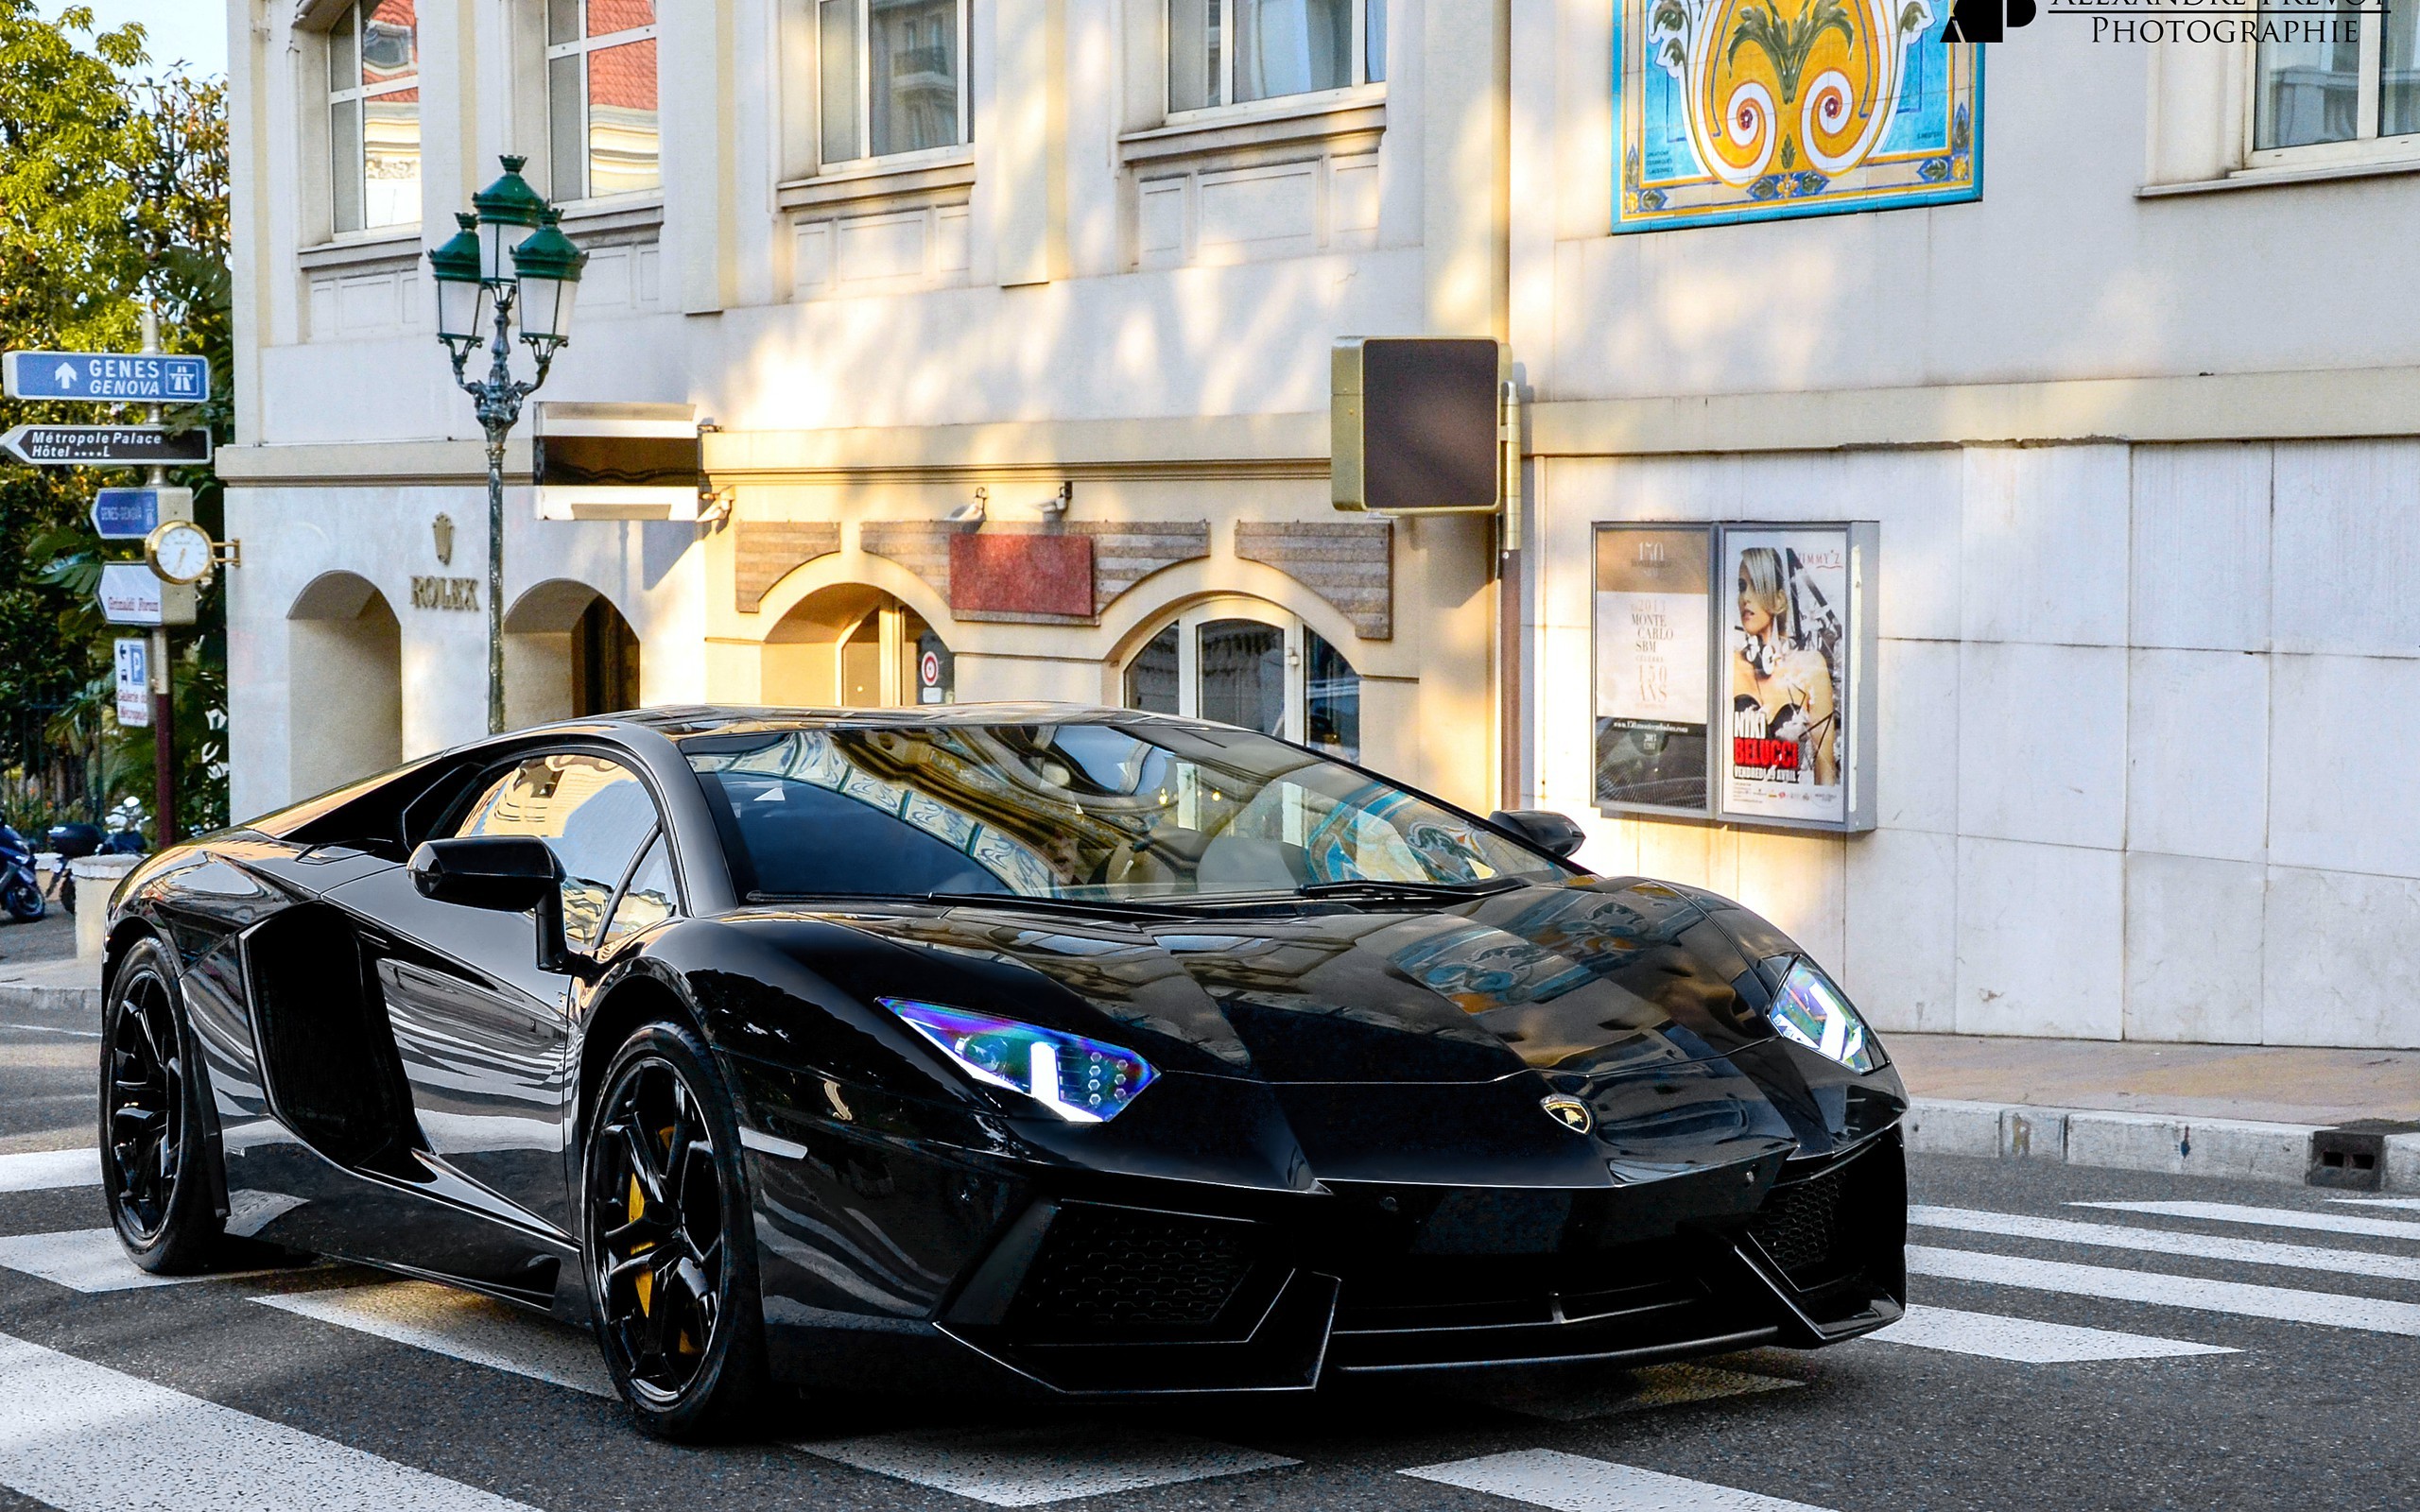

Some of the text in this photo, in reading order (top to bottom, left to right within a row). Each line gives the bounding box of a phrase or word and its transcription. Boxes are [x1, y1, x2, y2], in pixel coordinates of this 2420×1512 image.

[89, 359, 160, 378] GENES
[89, 380, 161, 395] GENOVA
[31, 431, 162, 446] Métropole Palace
[31, 444, 71, 457] Hôtel
[409, 576, 480, 611] ROLEX
[1632, 613, 1667, 627] MONTE
[1637, 627, 1674, 641] CARLO
[1635, 640, 1656, 653] SBM
[1734, 707, 1766, 739] NIKI
[1734, 738, 1799, 768] BELUCCI
